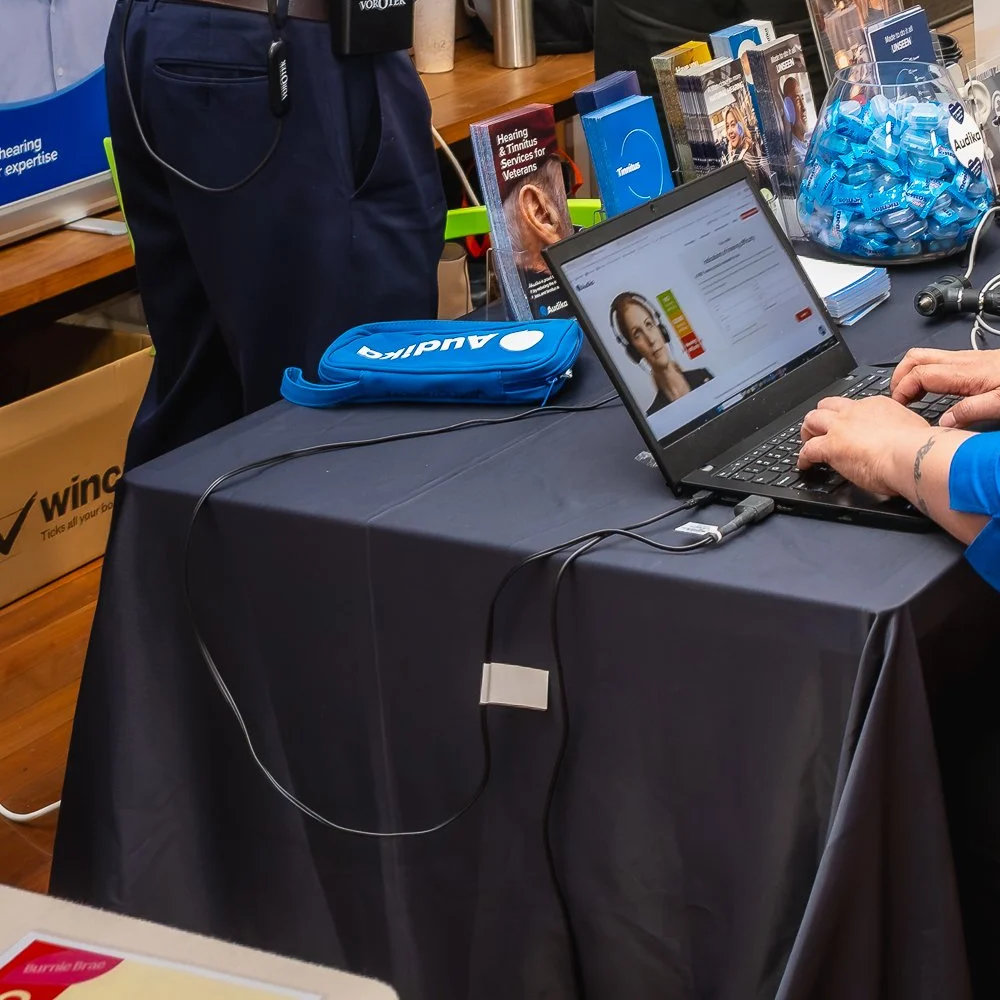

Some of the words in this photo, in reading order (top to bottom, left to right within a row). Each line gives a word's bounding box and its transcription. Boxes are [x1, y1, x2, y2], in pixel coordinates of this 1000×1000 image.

[891, 36, 912, 53] UNSEEN
[496, 128, 528, 145] Hearing
[499, 146, 505, 157] &
[506, 136, 538, 154] Tinnitus
[954, 130, 981, 152] Audika
[0, 138, 42, 159] hearing
[500, 152, 533, 169] Services
[534, 147, 546, 159] for
[4, 150, 58, 176] expertise
[502, 163, 537, 181] Veterans
[616, 161, 641, 178] Tinnitus
[547, 300, 568, 315] Audika
[357, 332, 500, 360] Audika
[40, 465, 122, 523] winc
[40, 524, 66, 541] Ticks
[67, 516, 78, 530] all
[79, 508, 100, 524] your
[101, 502, 114, 513] bo
[23, 961, 72, 974] Burnie
[72, 960, 106, 971] Brae
